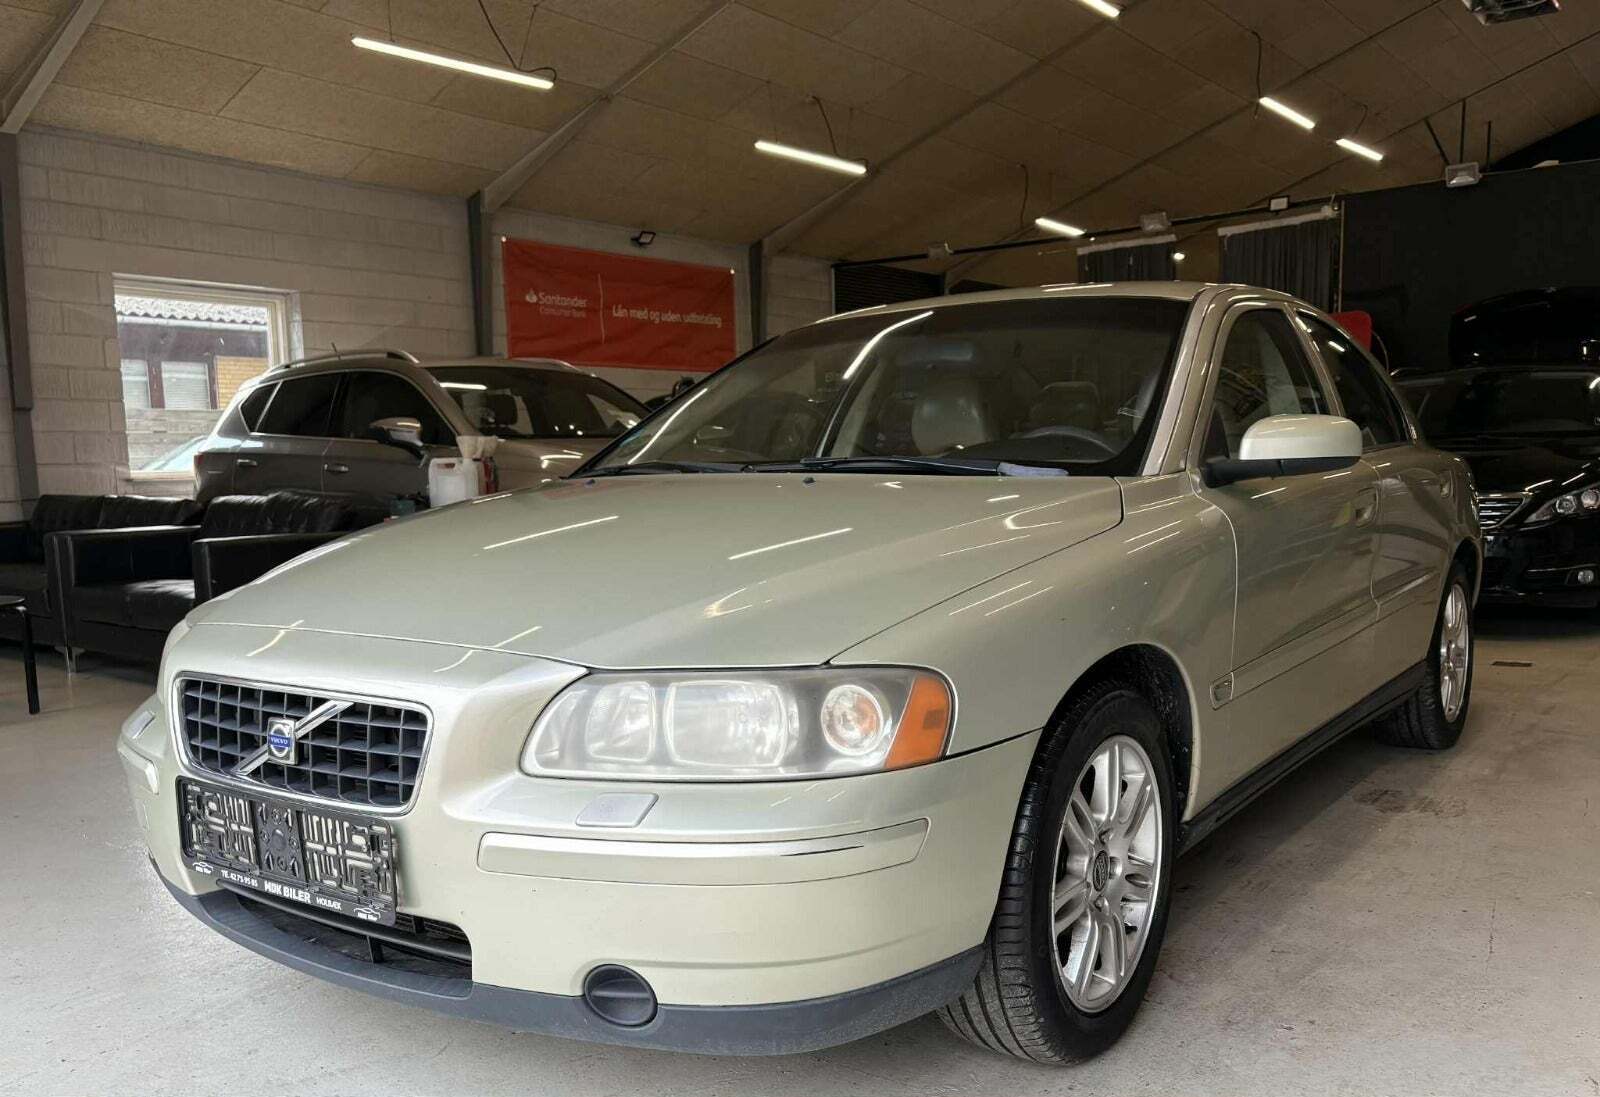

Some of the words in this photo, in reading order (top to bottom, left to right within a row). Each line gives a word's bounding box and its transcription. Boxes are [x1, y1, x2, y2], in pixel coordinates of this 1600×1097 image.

[538, 292, 587, 308] Santander
[629, 307, 648, 320] med
[649, 311, 661, 324] og
[661, 310, 682, 323] uden
[283, 886, 311, 904] BILER
